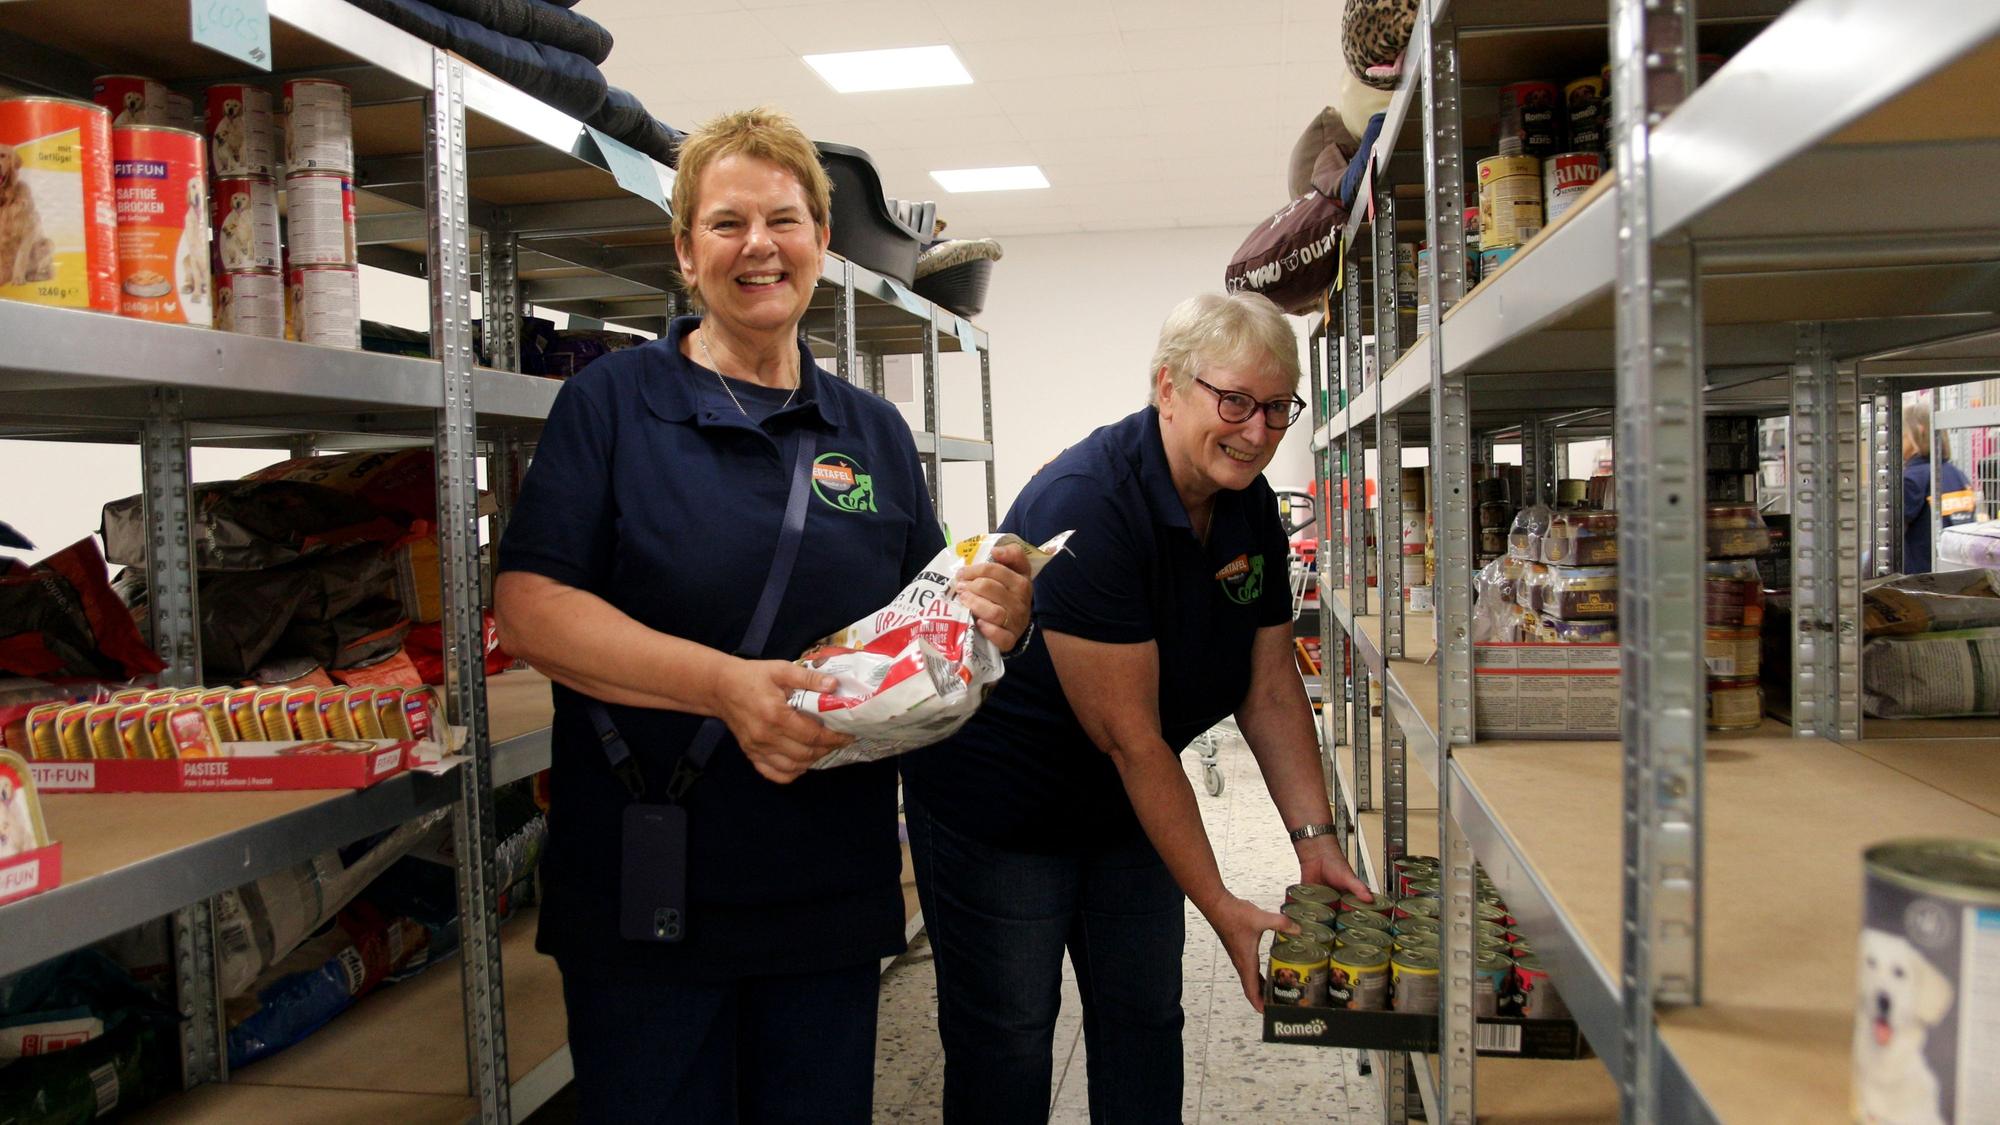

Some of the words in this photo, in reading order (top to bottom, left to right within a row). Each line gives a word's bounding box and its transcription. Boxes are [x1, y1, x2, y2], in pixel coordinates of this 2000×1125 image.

[1552, 163, 1598, 184] RINT
[116, 188, 157, 200] SAFTIGE
[117, 201, 164, 213] BROCKEN
[812, 467, 852, 481] ERTAFEL
[184, 762, 229, 776] PASTETE
[1274, 1019, 1322, 1036] Romeo
